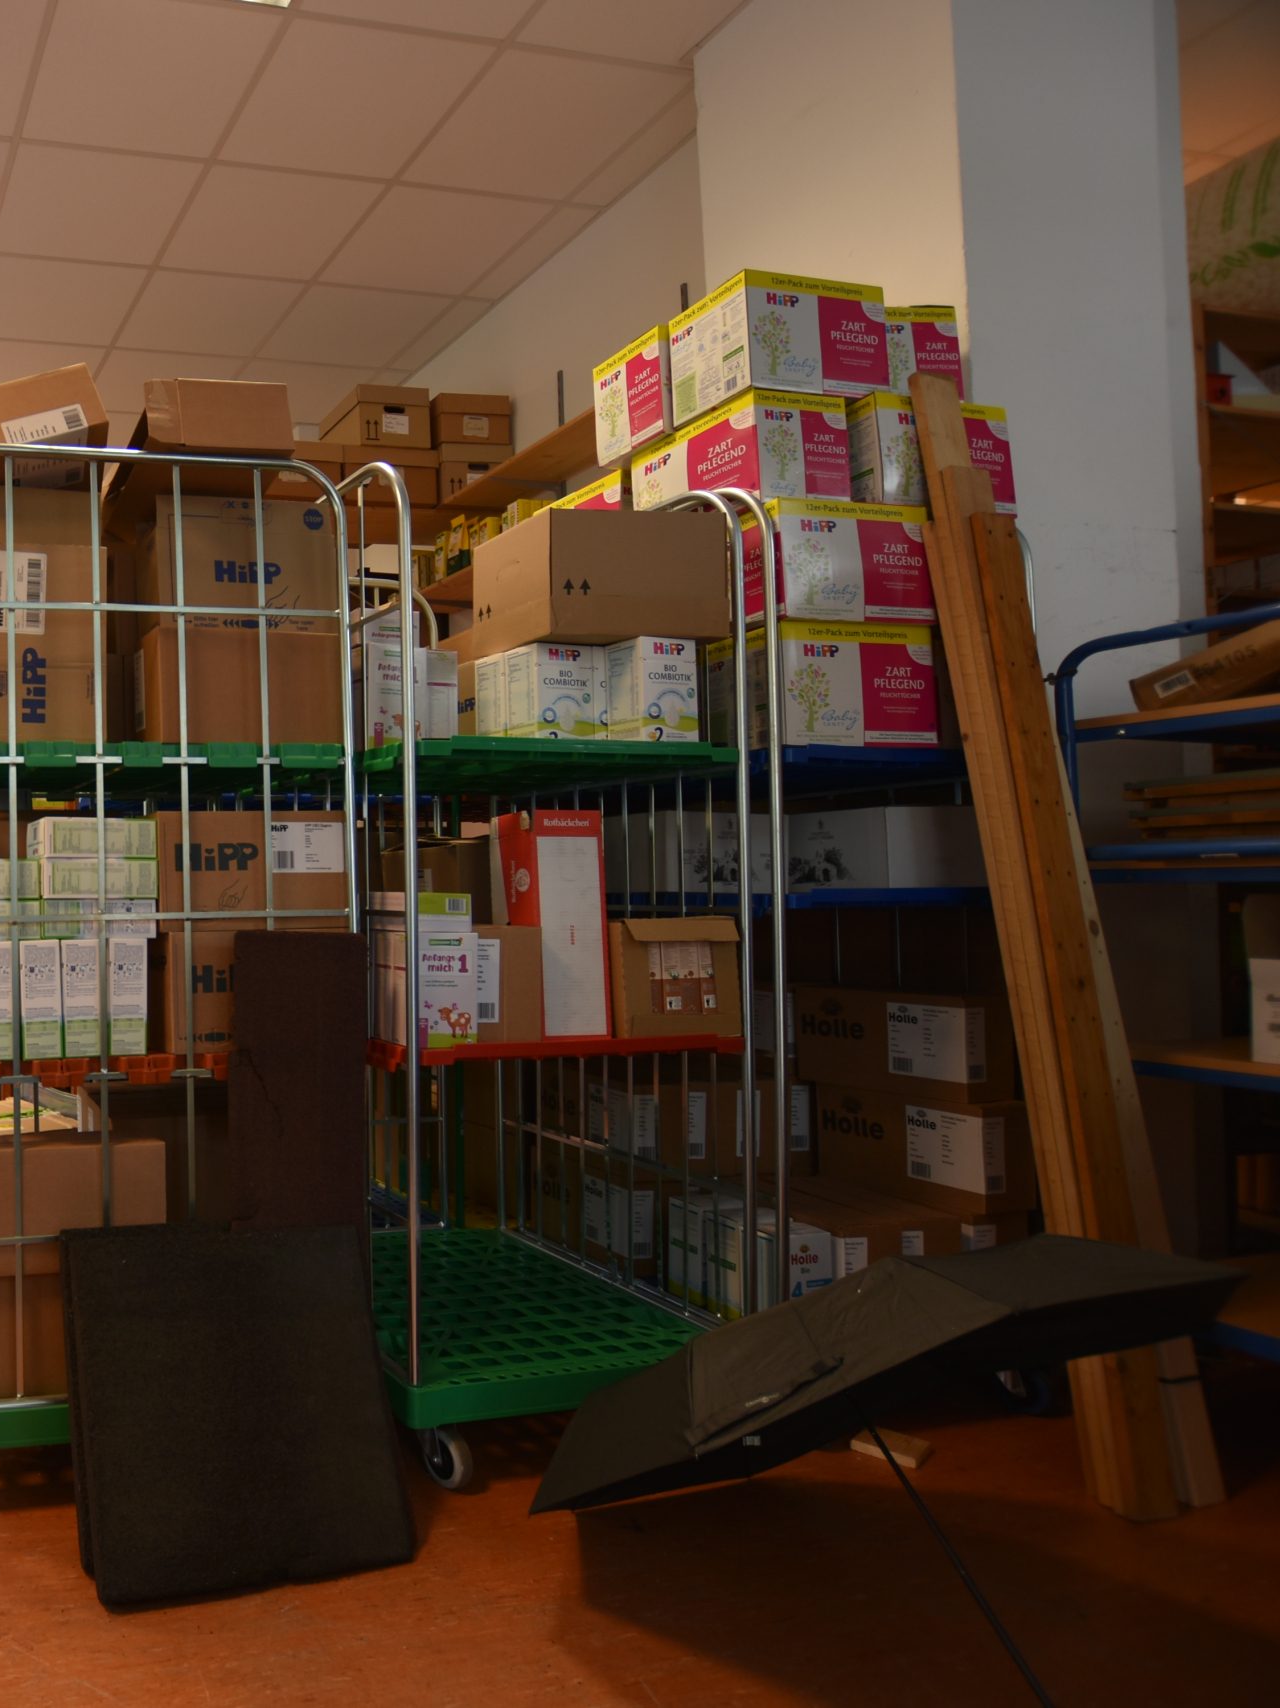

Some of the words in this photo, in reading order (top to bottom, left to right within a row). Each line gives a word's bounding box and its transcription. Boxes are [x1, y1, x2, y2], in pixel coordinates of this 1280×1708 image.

[766, 292, 799, 308] HiPP
[841, 321, 867, 332] ZART
[885, 324, 905, 334] iPP
[672, 326, 694, 346] HiPP
[830, 330, 879, 345] PFLEGEND
[925, 342, 948, 351] ZART
[917, 352, 959, 361] PFLEGEND
[600, 371, 621, 391] HiPP
[634, 368, 651, 384] ZART
[628, 374, 659, 398] PFLEGEND
[764, 409, 794, 422] HiPP
[813, 433, 835, 443] ZART
[972, 438, 993, 449] ZART
[708, 438, 733, 458] ZART
[805, 444, 846, 455] PFLEGEND
[645, 453, 671, 476] HiPP
[697, 444, 746, 475] PFLEGEND
[806, 503, 840, 513] 12er-Pack
[859, 507, 903, 518] Vorteilspreis
[800, 519, 837, 533] HiPP
[883, 543, 909, 554] ZART
[873, 554, 923, 567] PFLEGEND
[808, 627, 843, 638] 12er-Pack
[862, 629, 908, 641] Vorteilspreis
[548, 648, 581, 661] HiPP
[653, 642, 685, 655] HiPP
[803, 644, 839, 657] HiPP
[559, 670, 573, 678] BIO
[664, 664, 677, 672] BIO
[885, 667, 912, 677] ZART
[22, 647, 46, 723] HiPP
[874, 678, 925, 690] PFLEGEND
[271, 824, 288, 832] HiPP
[175, 843, 259, 872] HiPP
[458, 954, 469, 973] 1
[192, 964, 234, 994] Hi
[888, 1012, 918, 1025] Holle
[801, 1013, 865, 1040] Holle
[821, 1107, 885, 1141] Holle
[907, 1115, 937, 1130] Holle
[791, 1253, 819, 1266] Holle
